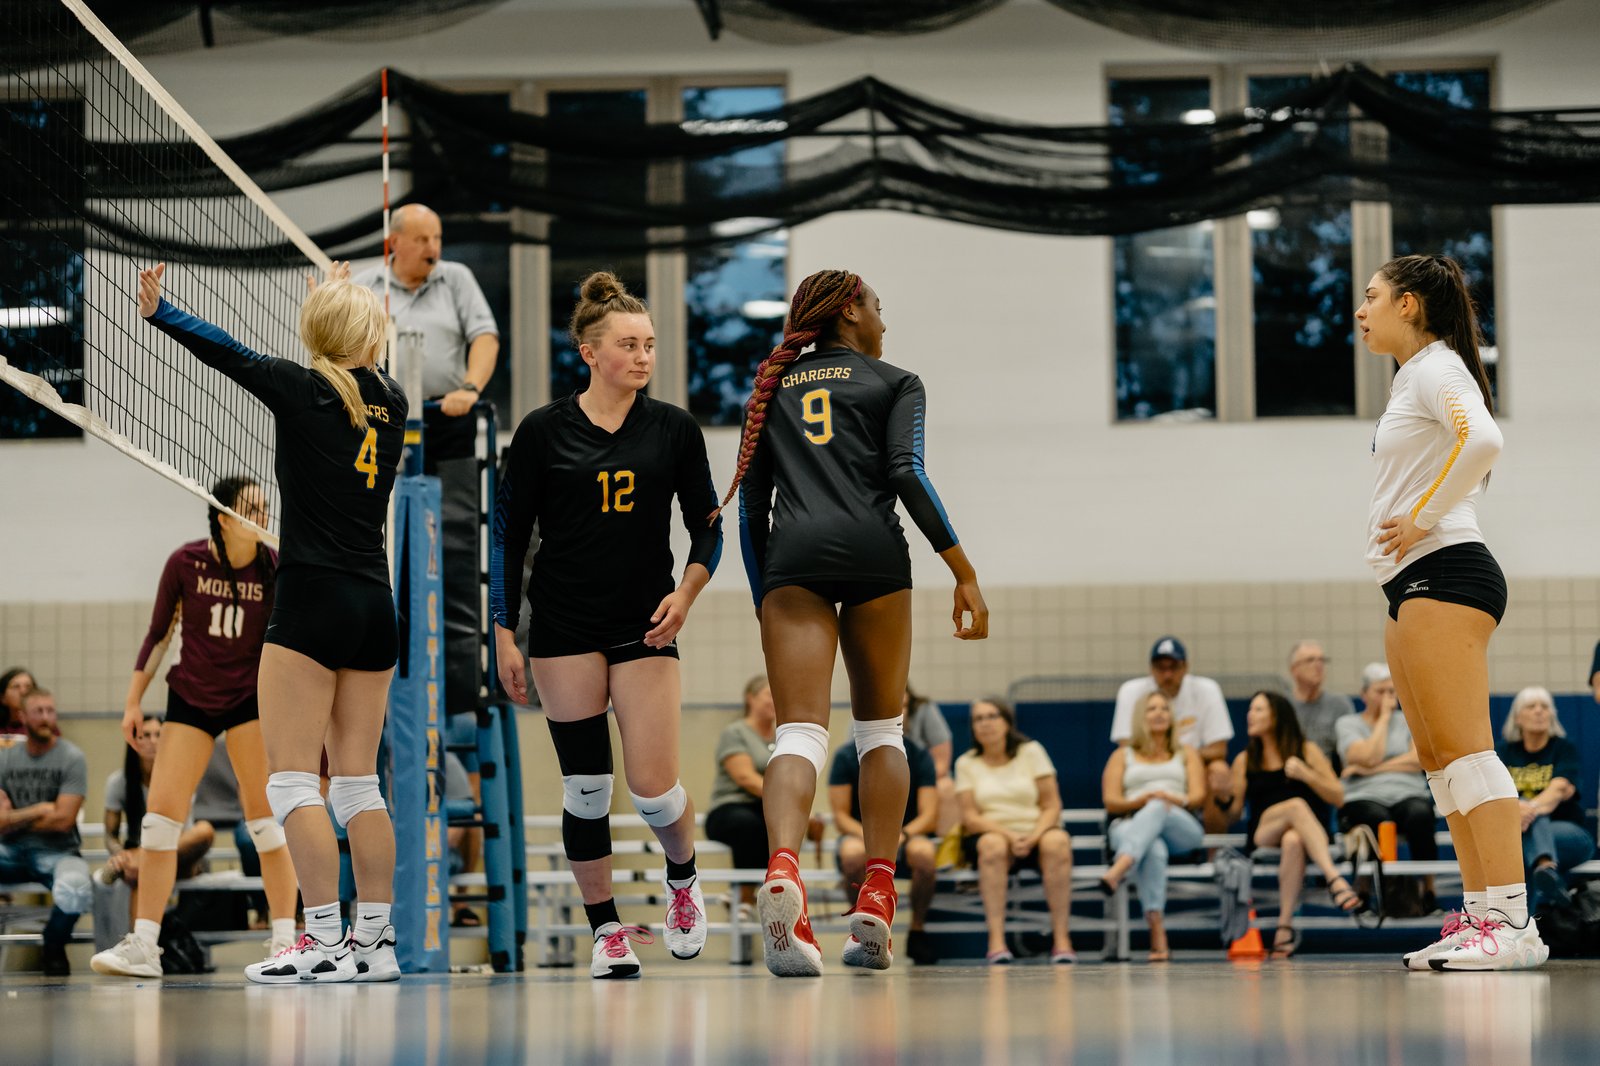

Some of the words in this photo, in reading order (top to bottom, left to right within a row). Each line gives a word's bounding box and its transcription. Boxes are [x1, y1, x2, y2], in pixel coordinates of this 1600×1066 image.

[781, 367, 852, 389] CHARGERS
[800, 388, 835, 445] 9
[354, 427, 378, 489] 4
[597, 470, 635, 513] 12
[196, 575, 264, 602] MORRIS
[208, 602, 245, 639] 10
